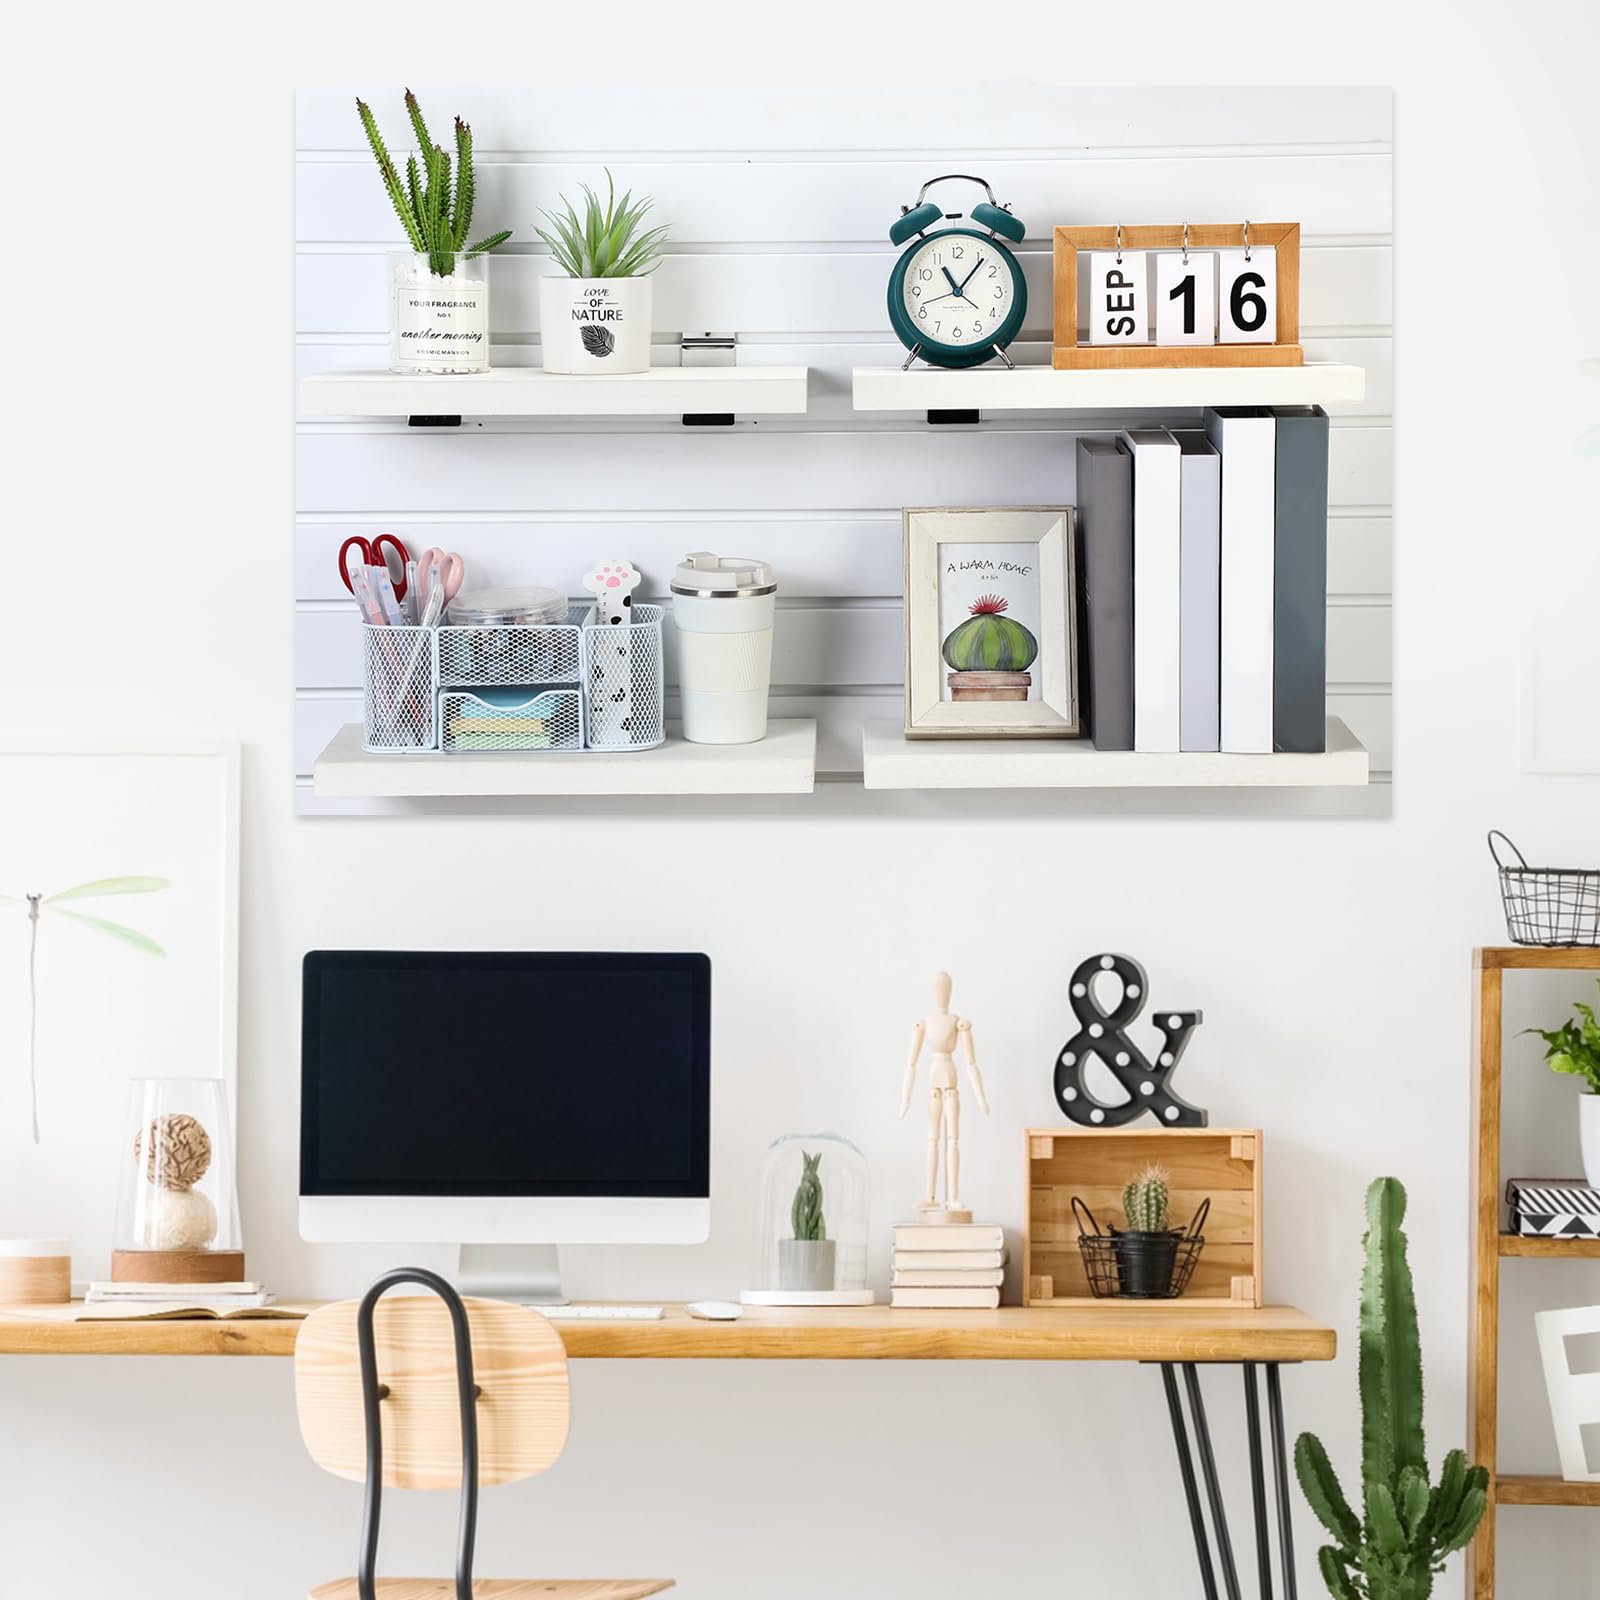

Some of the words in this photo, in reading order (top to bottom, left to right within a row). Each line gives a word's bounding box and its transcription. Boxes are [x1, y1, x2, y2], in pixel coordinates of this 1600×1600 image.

[933, 253, 942, 265] 11
[952, 246, 964, 259] 12
[919, 268, 933, 281] 10
[988, 265, 997, 278] 2
[583, 288, 610, 297] LOVE
[911, 286, 922, 298] 9
[993, 285, 1003, 299] 3
[409, 300, 430, 308] YOUR
[431, 300, 477, 309] FRAGRANCE
[589, 298, 604, 308] OF
[1106, 269, 1136, 337] SEP
[571, 309, 624, 322] NATURE
[918, 305, 928, 319] 8
[989, 307, 996, 318] 4
[934, 321, 941, 333] 7
[952, 326, 963, 338] 6
[973, 320, 983, 333] 5
[401, 328, 441, 340] another
[442, 331, 483, 343] morning
[947, 563, 956, 573] A
[959, 559, 995, 570] WARM
[998, 561, 1033, 576] HOME
[1053, 952, 1208, 1128] &
